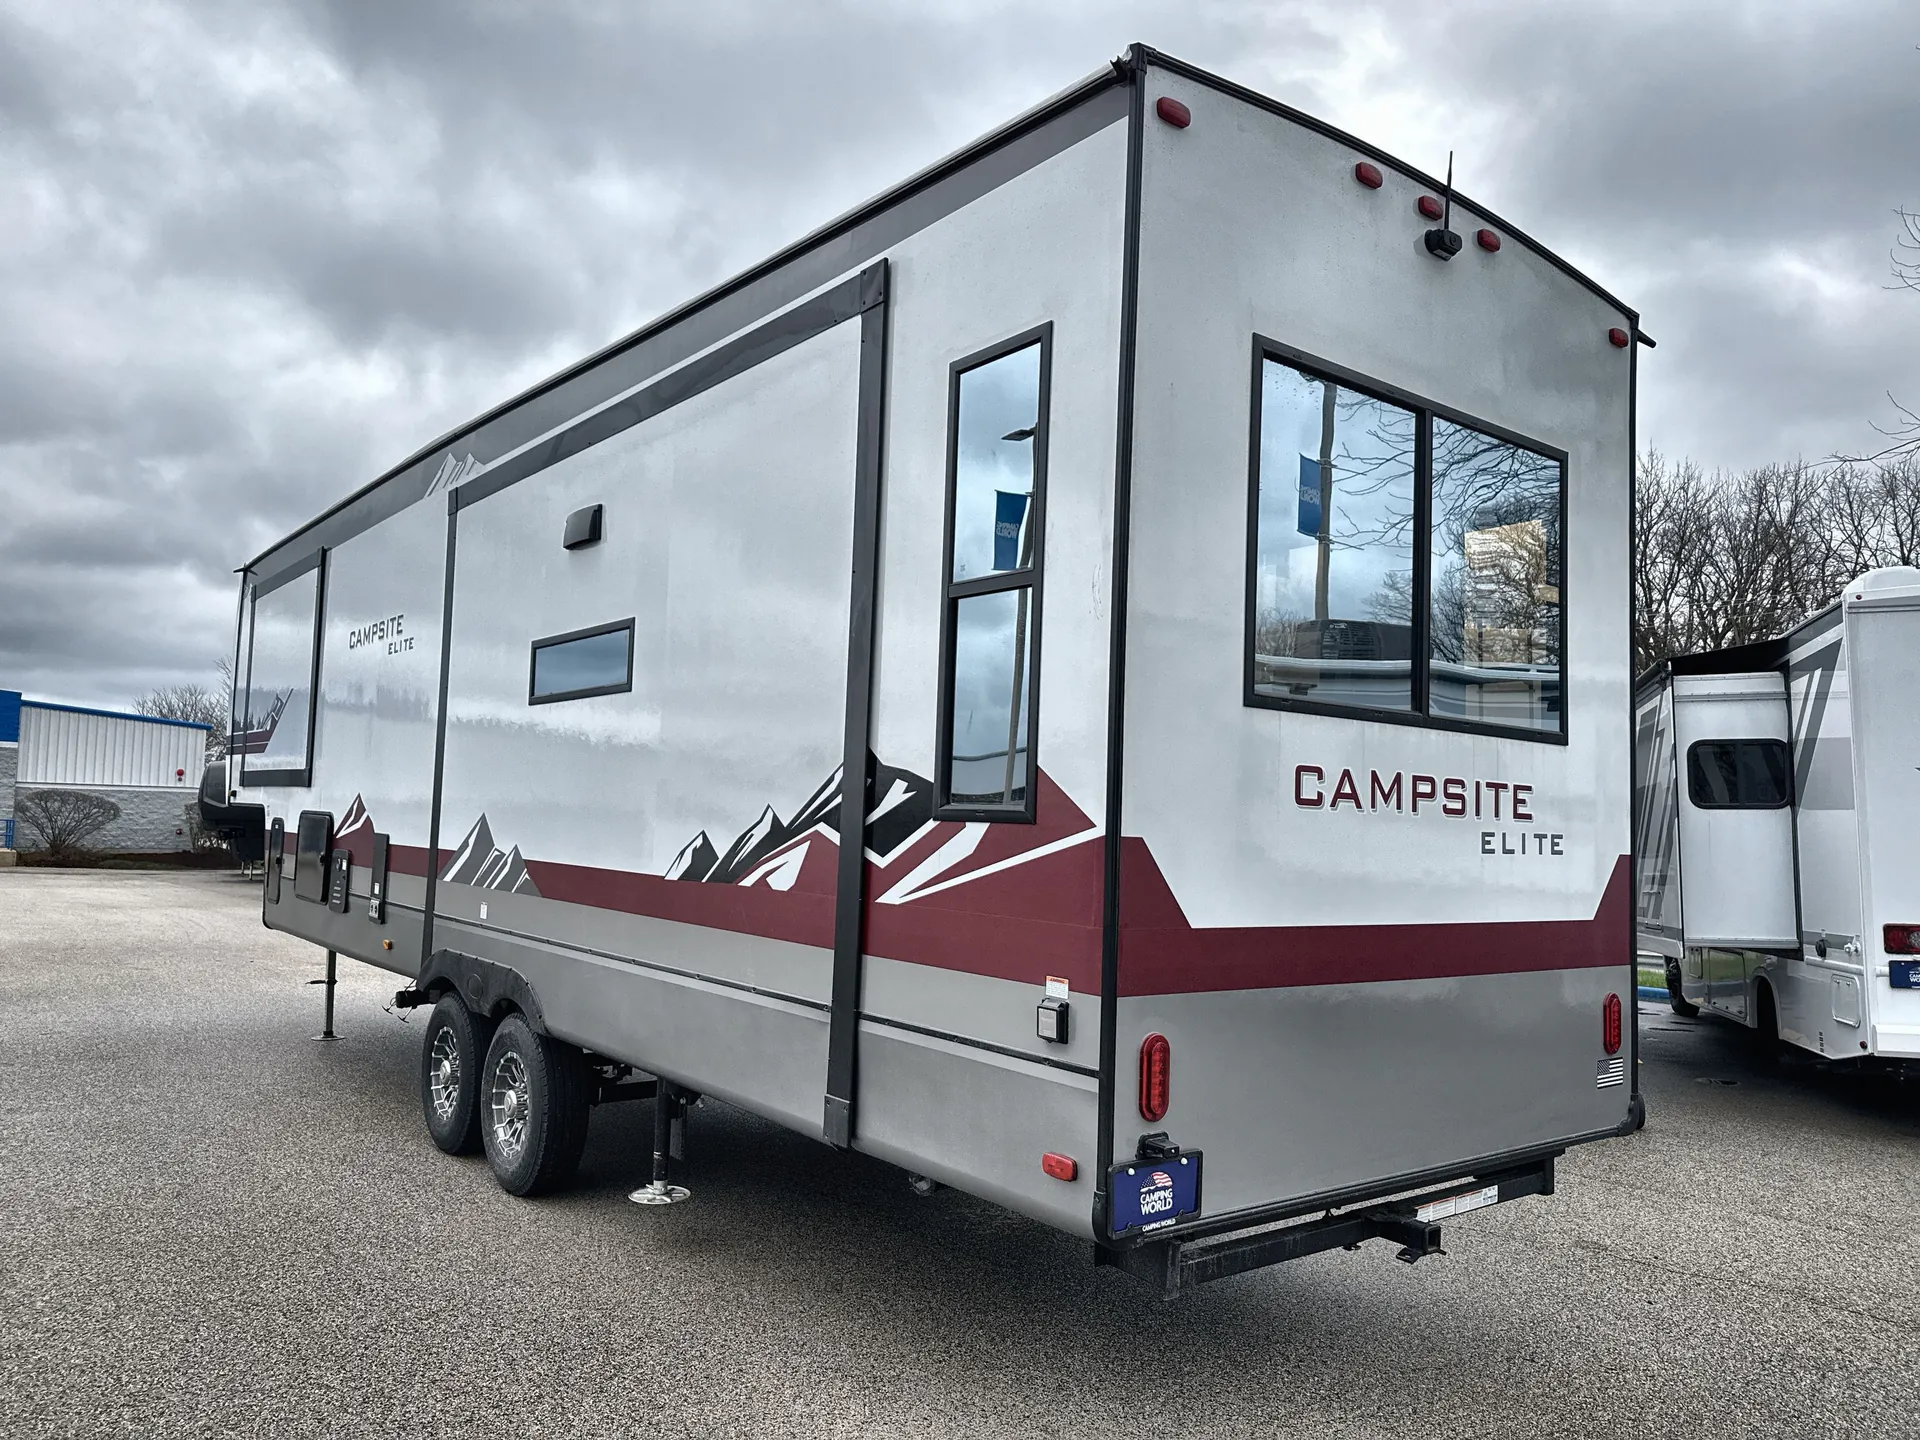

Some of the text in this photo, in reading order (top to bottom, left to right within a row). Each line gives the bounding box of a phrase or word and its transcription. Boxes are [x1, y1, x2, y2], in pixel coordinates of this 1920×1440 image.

[349, 614, 404, 650] CAMPSITE
[388, 637, 414, 655] ELITE
[1294, 764, 1534, 822] CAMPSITE
[1481, 831, 1564, 855] ELITE
[1140, 1188, 1173, 1204] CAMPING
[1140, 1198, 1173, 1215] WORLD
[1142, 1218, 1176, 1232] CAMPING WORLD
